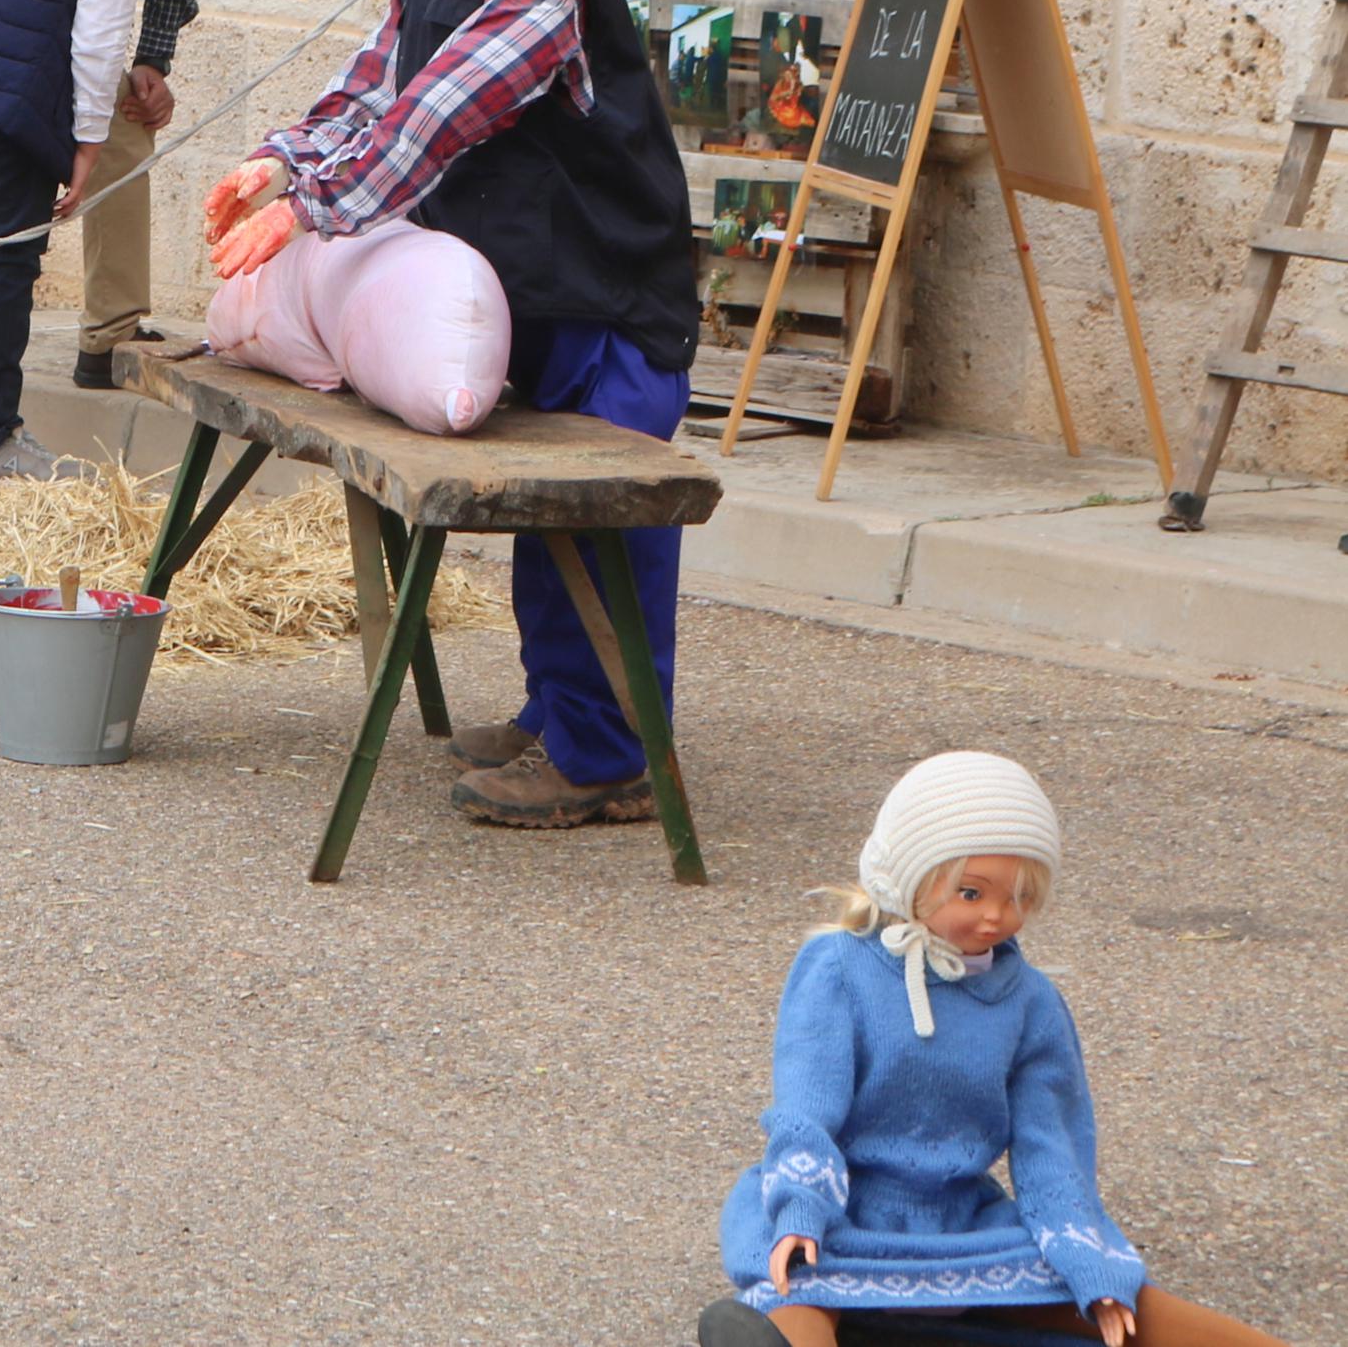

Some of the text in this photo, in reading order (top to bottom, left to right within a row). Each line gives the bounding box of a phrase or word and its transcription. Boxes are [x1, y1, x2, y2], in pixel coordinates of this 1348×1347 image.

[869, 8, 927, 60] DE LA
[825, 91, 915, 161] MATANZA
